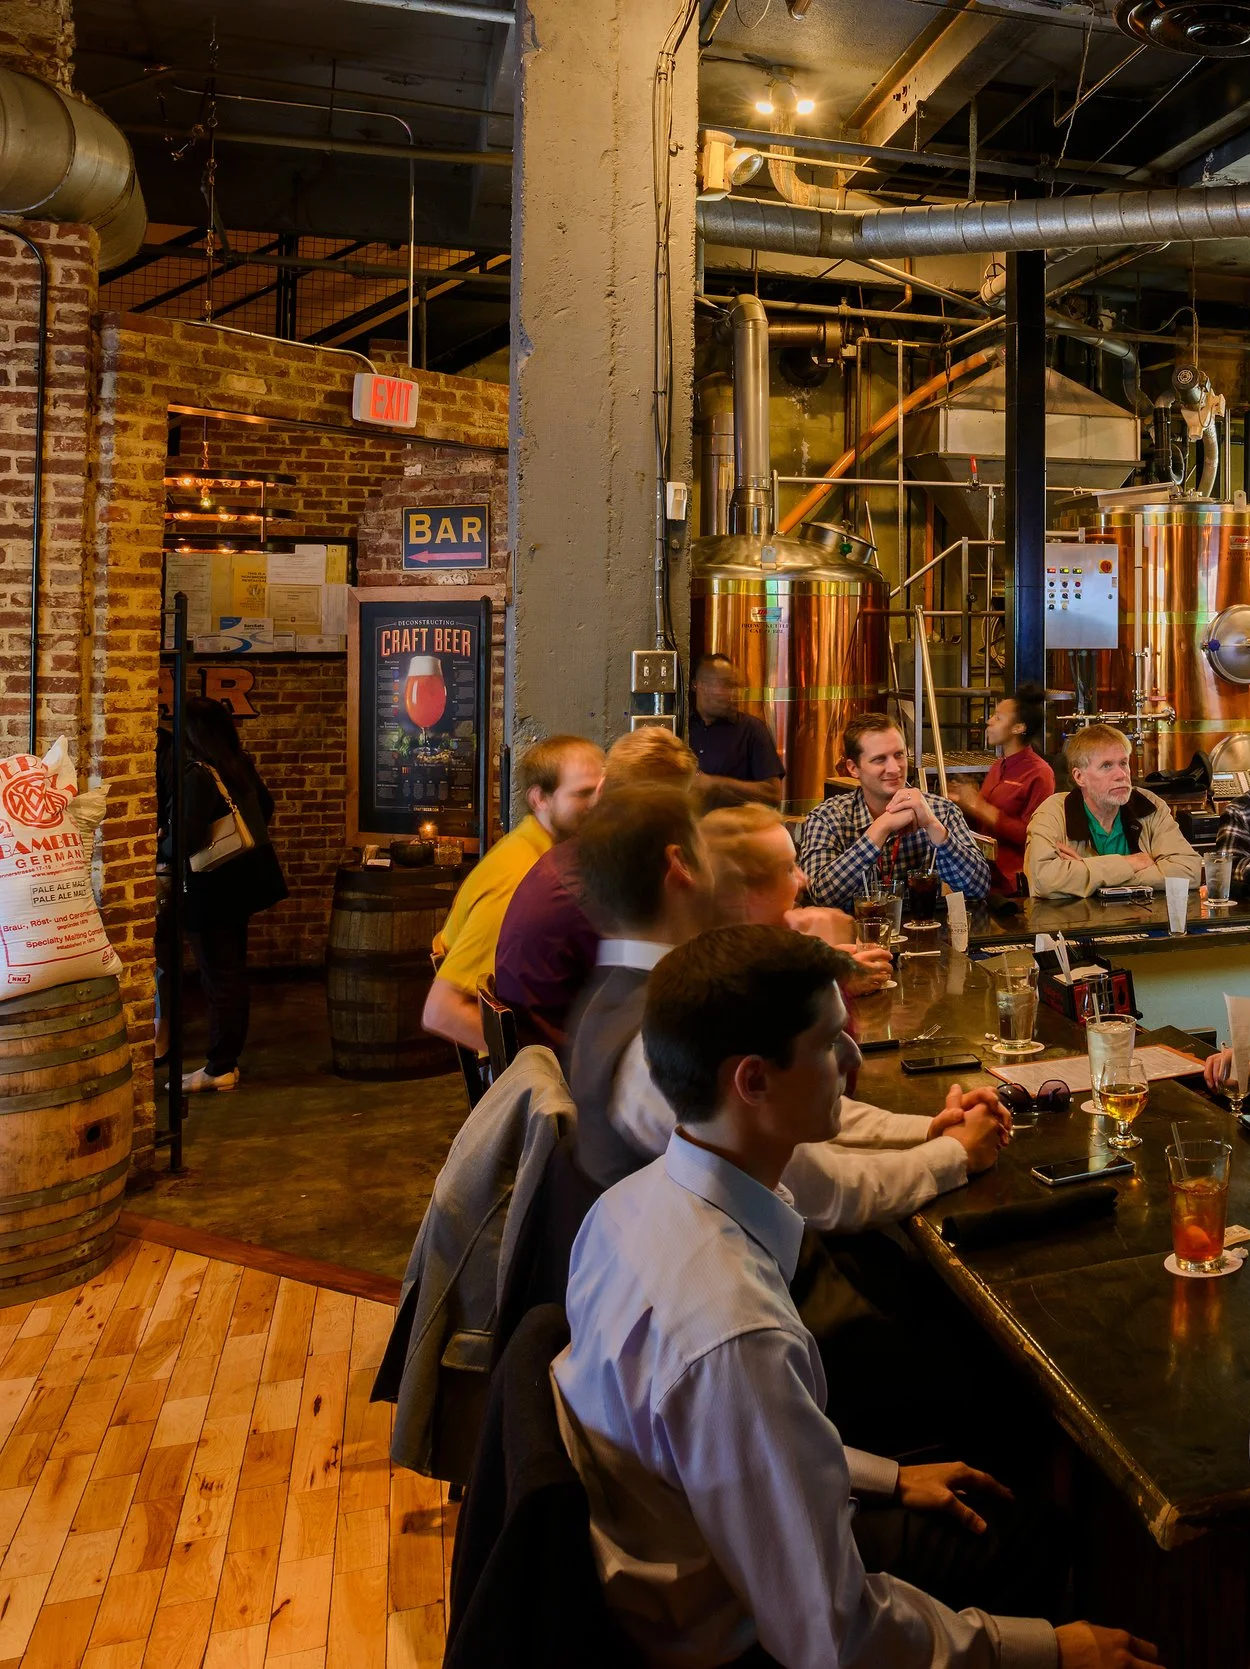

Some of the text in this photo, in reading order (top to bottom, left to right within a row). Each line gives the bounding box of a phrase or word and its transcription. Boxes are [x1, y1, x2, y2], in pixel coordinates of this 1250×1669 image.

[370, 376, 413, 423] EXIT
[408, 513, 483, 545] BAR
[381, 628, 471, 657] CRAFT BEER
[32, 884, 55, 895] PALE
[57, 882, 71, 891] ALE
[33, 894, 57, 904] PALE
[58, 891, 72, 900] ALE
[54, 915, 68, 923] und
[26, 936, 63, 949] Specialty
